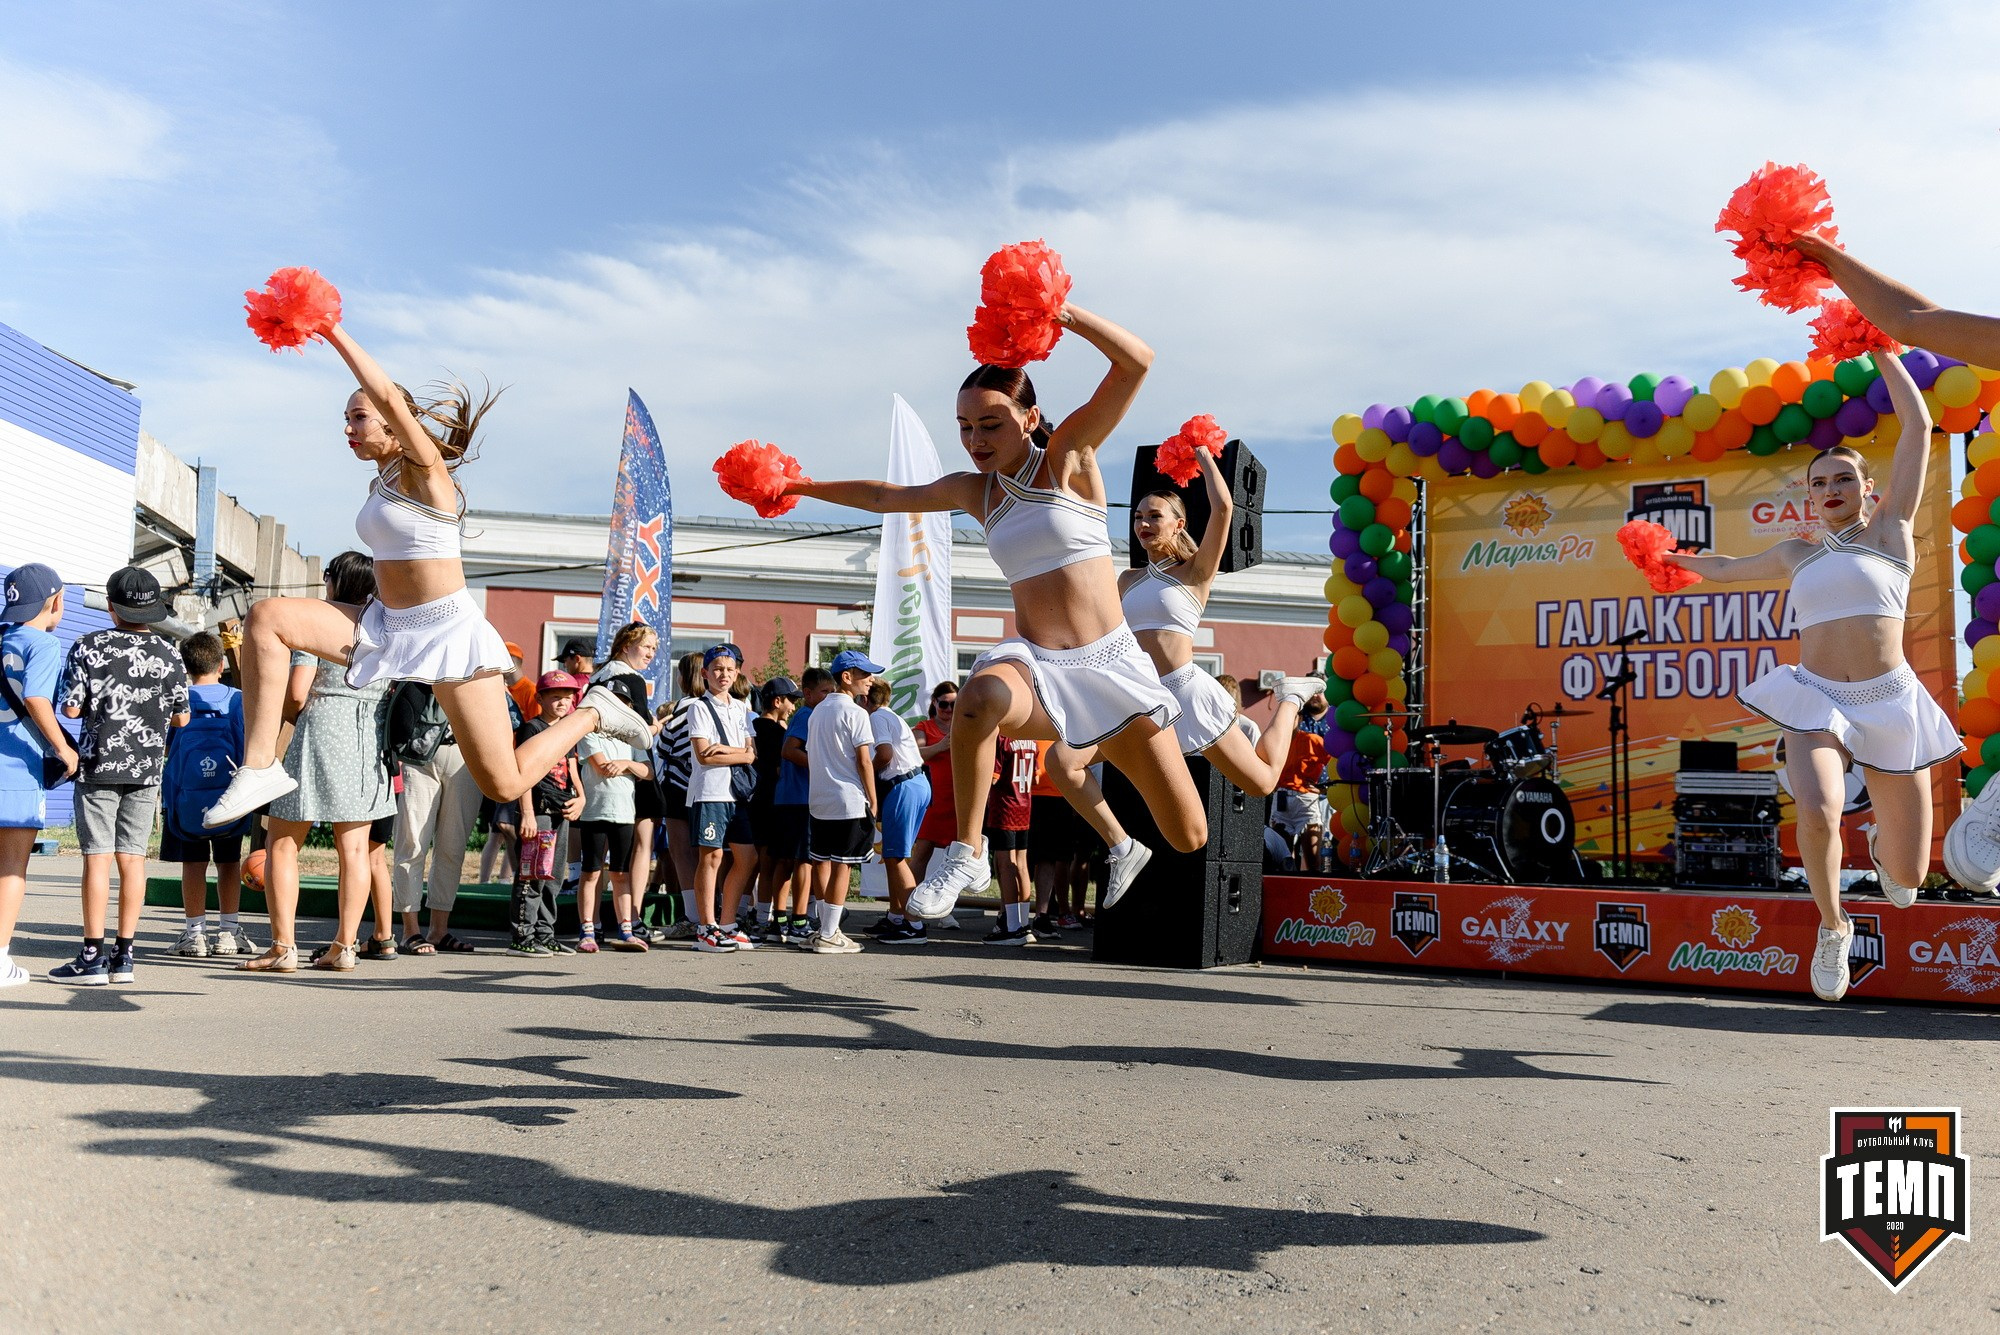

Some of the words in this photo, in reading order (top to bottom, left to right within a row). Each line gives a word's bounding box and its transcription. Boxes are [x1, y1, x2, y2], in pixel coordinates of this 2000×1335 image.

[1752, 500, 1819, 524] GAL
[1633, 509, 1706, 543] МП
[1012, 753, 1034, 793] 47
[1525, 792, 1553, 803] YAMAHA
[1275, 919, 1376, 947] МарияРа
[1396, 911, 1435, 934] ТЕМП
[1461, 917, 1570, 942] GALAXY
[1599, 922, 1645, 947] ТЕМП
[1669, 943, 1798, 975] МарияРа
[1849, 934, 1878, 960] МП
